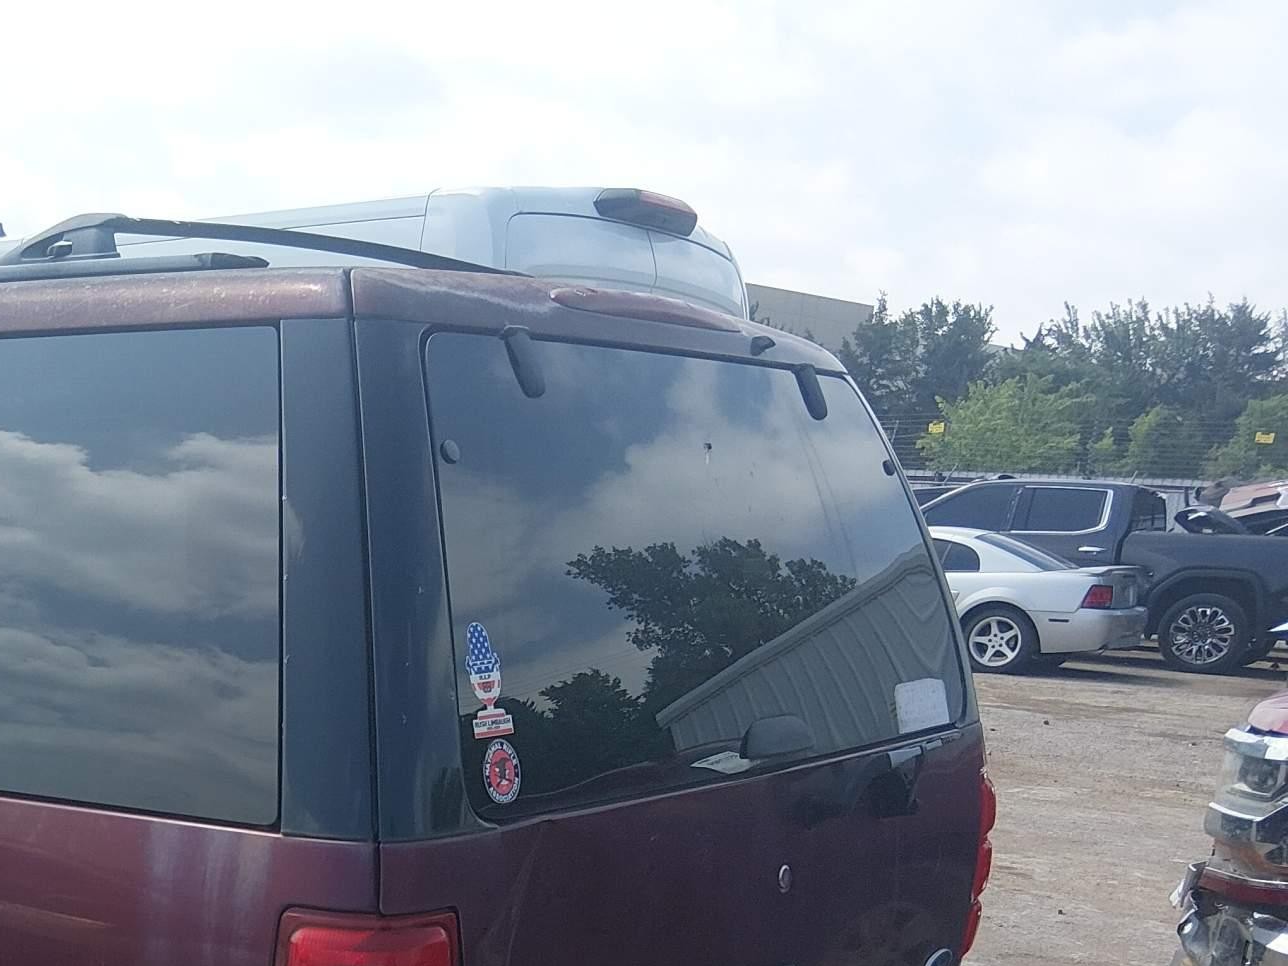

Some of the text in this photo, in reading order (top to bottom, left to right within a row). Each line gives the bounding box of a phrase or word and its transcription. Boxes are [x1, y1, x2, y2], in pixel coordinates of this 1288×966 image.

[485, 742, 518, 776] NATIONAL RIFLE
[488, 777, 519, 802] ASSOCIATION
